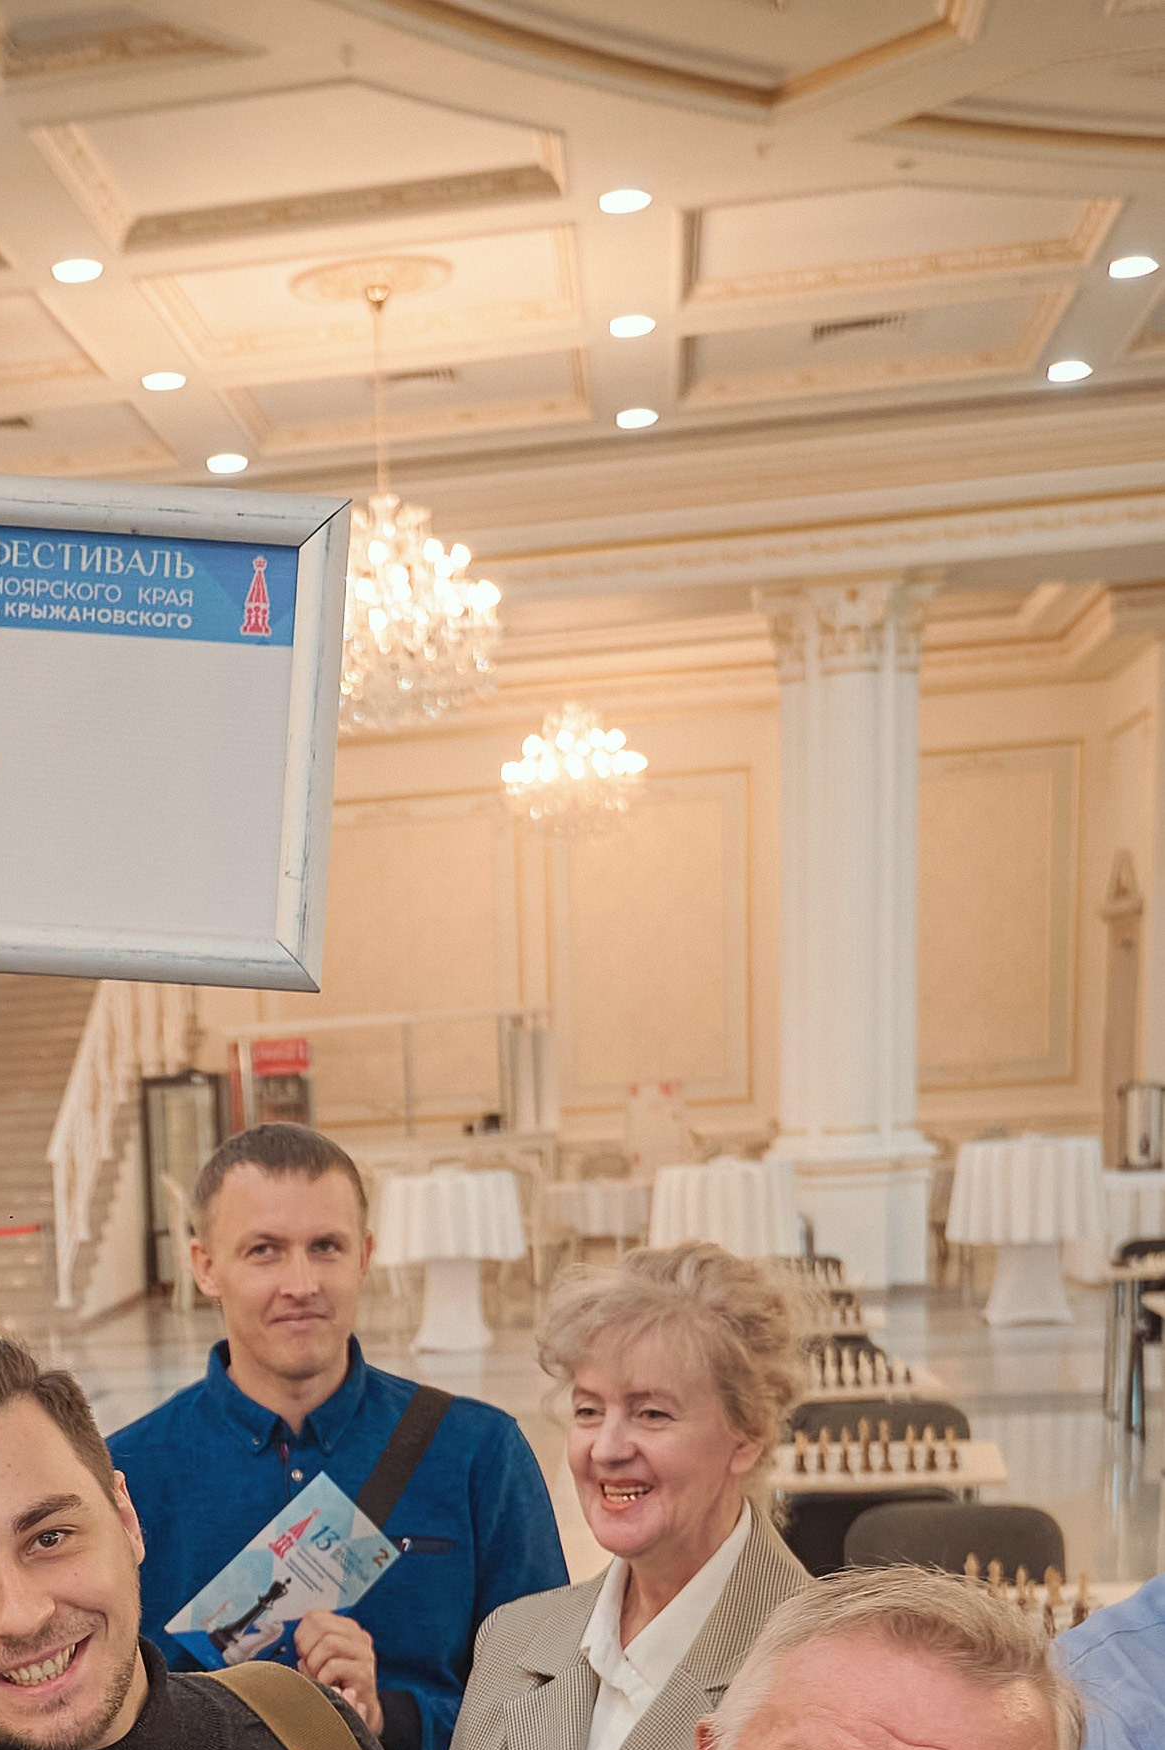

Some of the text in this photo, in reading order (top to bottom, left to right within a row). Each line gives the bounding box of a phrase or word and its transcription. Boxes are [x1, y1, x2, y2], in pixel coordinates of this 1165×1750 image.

[138, 586, 194, 607] КРАЯ
[4, 602, 193, 629] КРЫЖАНОВСКОГО
[310, 1525, 340, 1551] 13
